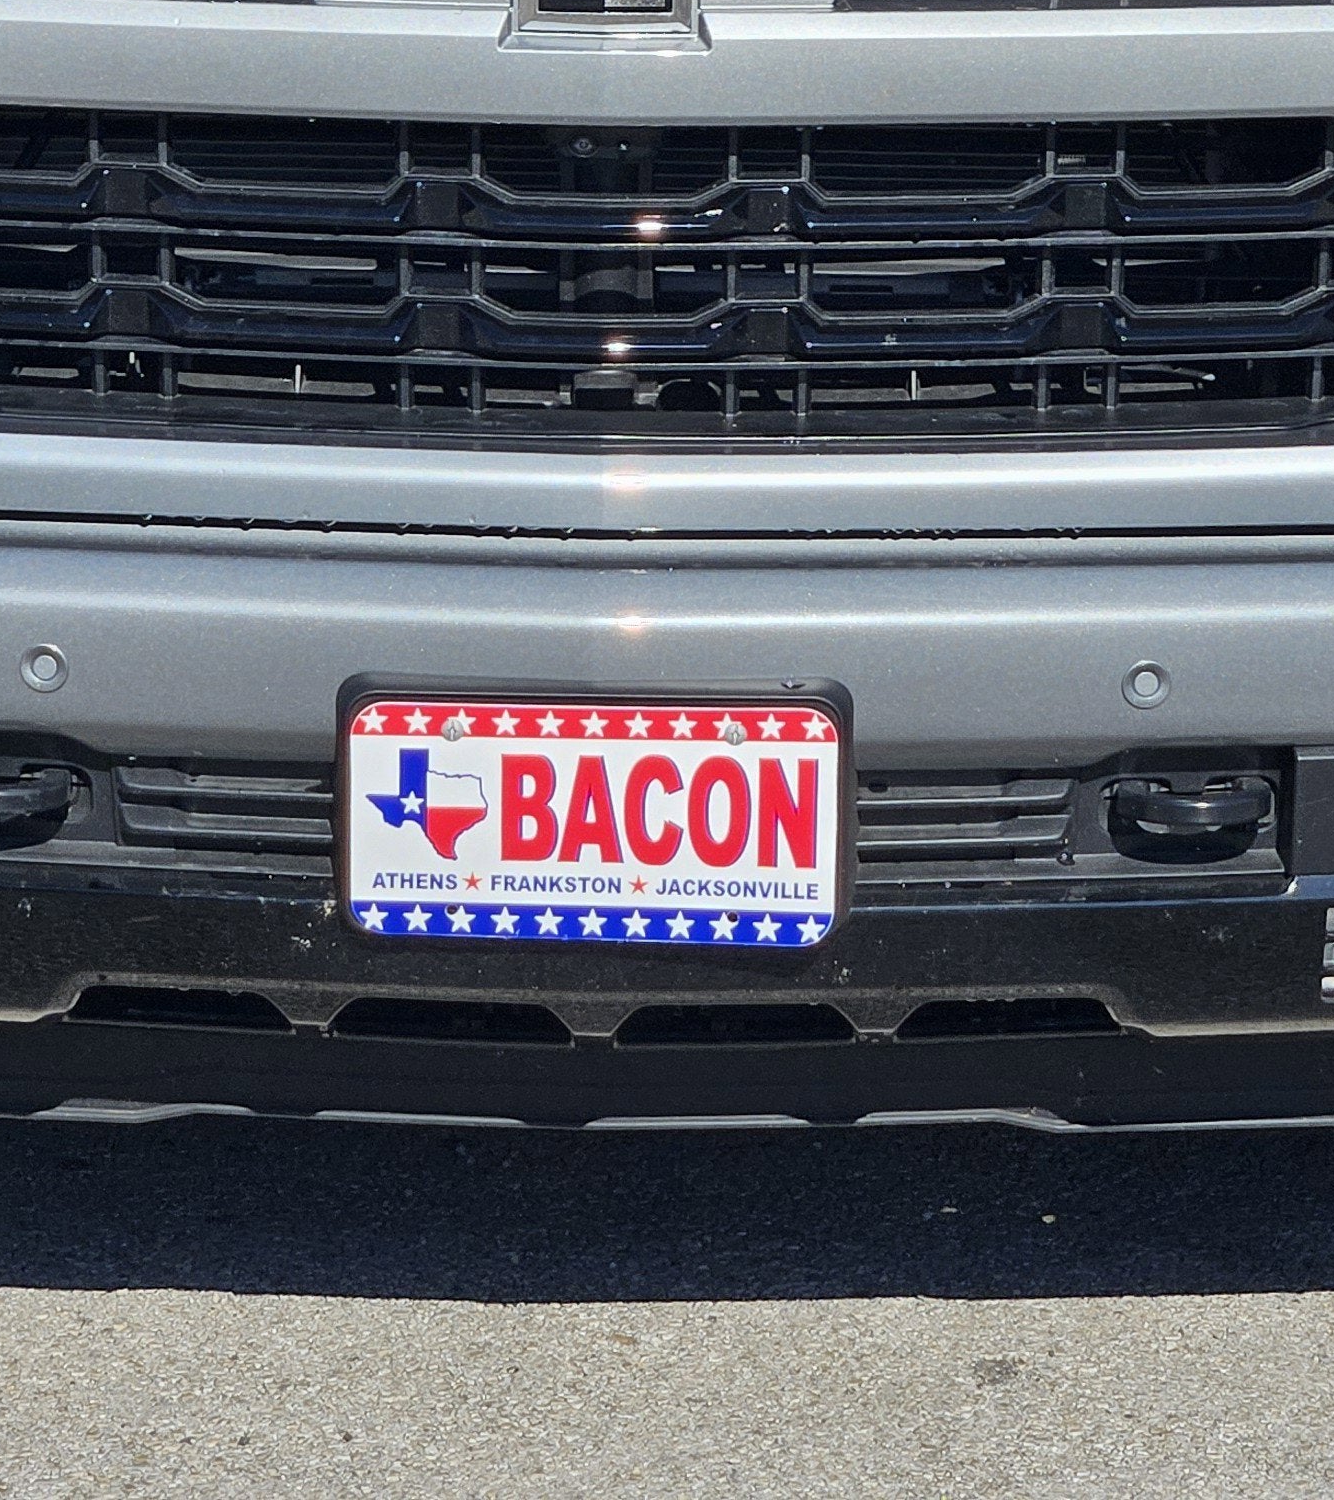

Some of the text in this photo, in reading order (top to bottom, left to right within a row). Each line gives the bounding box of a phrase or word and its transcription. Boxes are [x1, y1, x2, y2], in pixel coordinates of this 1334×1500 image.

[501, 753, 819, 869] BACON
[372, 872, 819, 901] ATHENS FRANKSTON JACKSONVILLE
